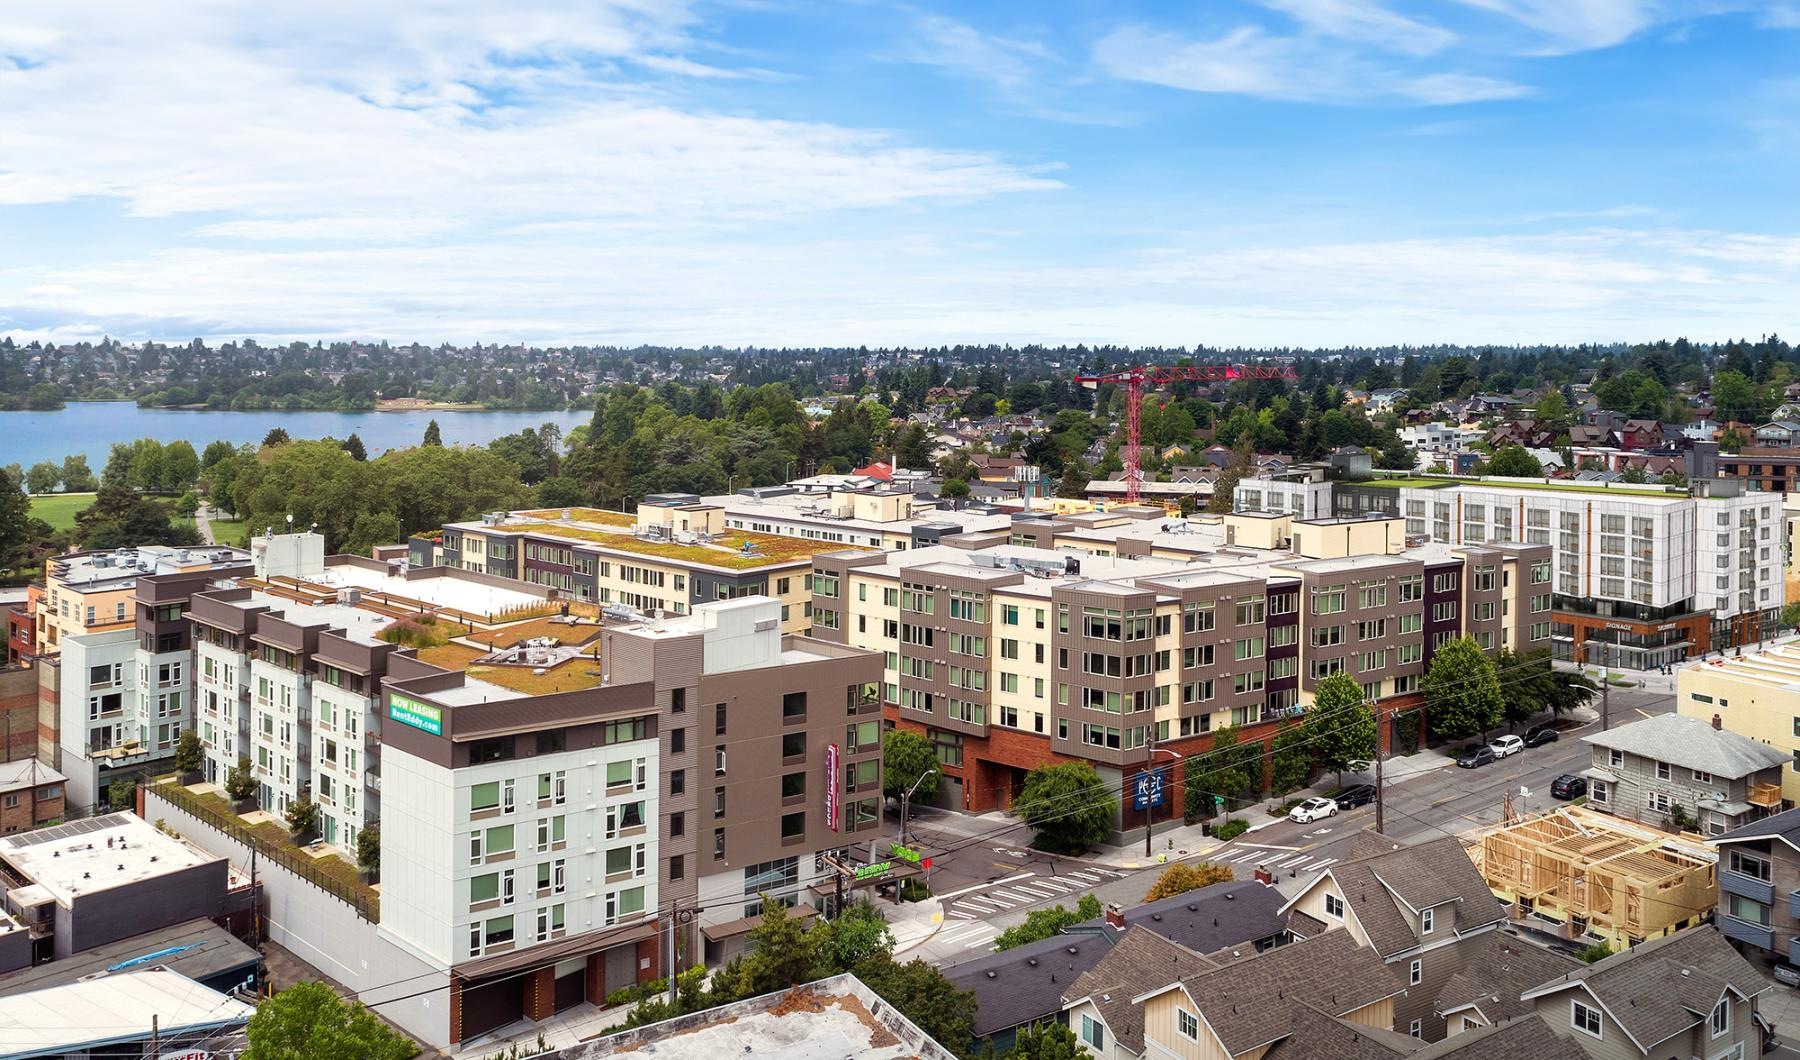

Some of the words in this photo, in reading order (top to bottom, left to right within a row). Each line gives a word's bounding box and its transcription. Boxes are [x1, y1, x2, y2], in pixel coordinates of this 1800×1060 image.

[1606, 622, 1633, 631] SIGNAGE
[392, 695, 408, 710] NOW
[409, 701, 439, 720] LEASING
[392, 706, 438, 731] RentEddy.com
